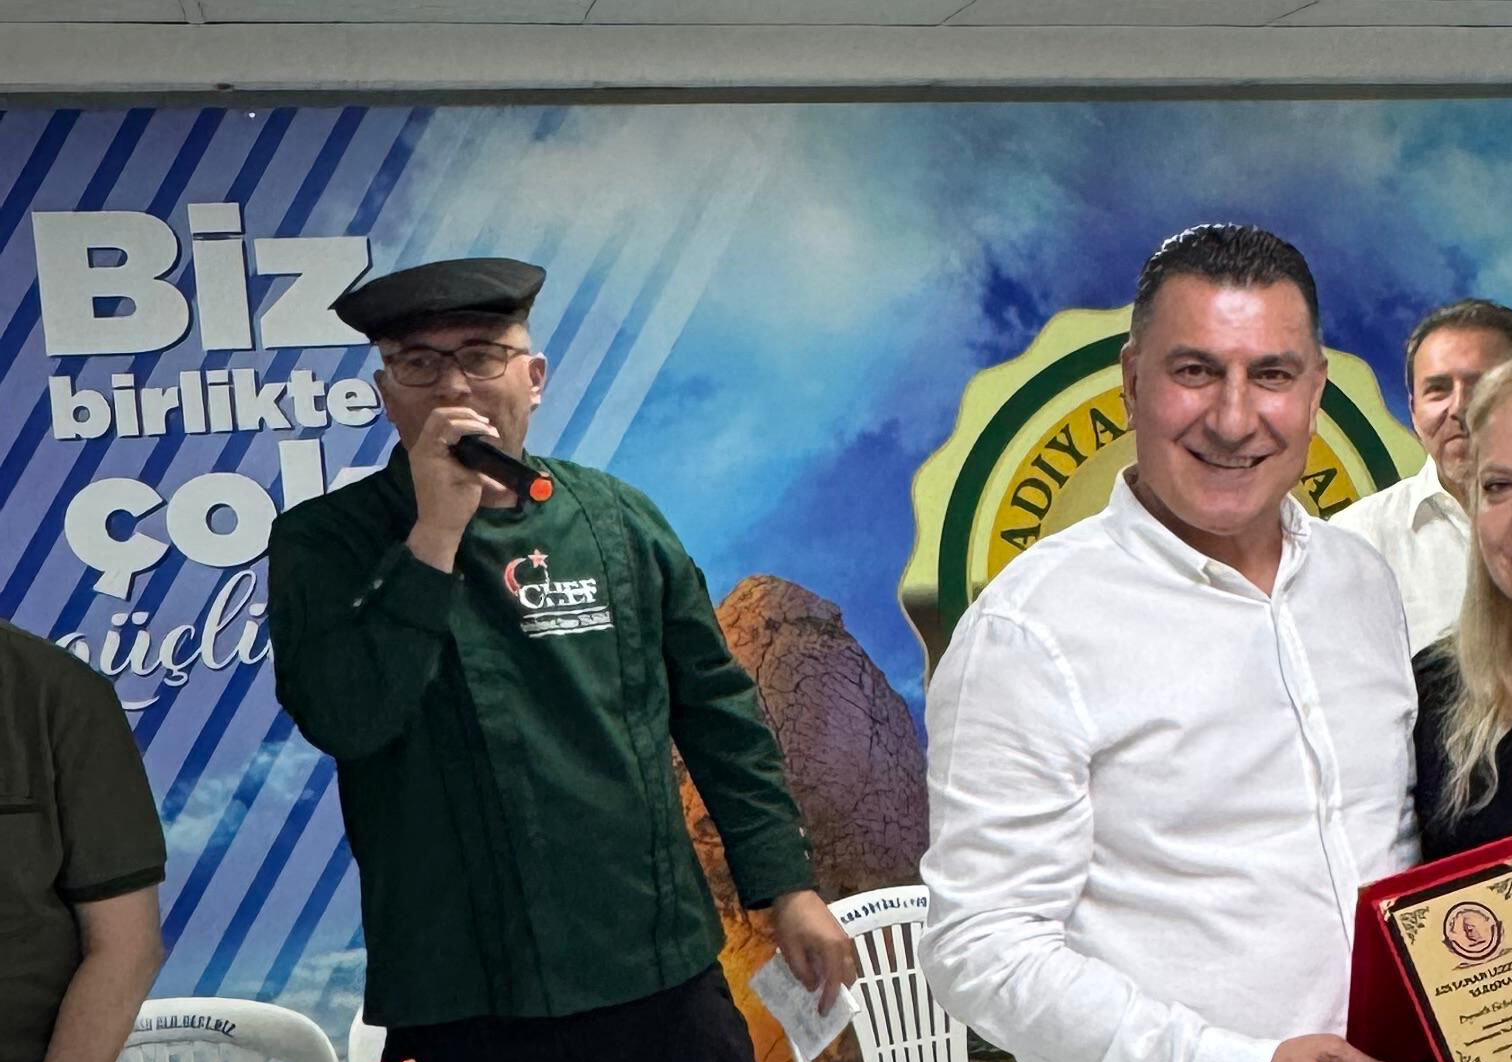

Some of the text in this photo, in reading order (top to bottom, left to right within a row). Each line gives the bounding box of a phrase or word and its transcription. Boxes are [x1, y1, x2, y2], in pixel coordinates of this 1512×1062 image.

[32, 202, 373, 356] Biz
[49, 369, 381, 439] birlikte
[1000, 393, 1128, 551] ADIYA
